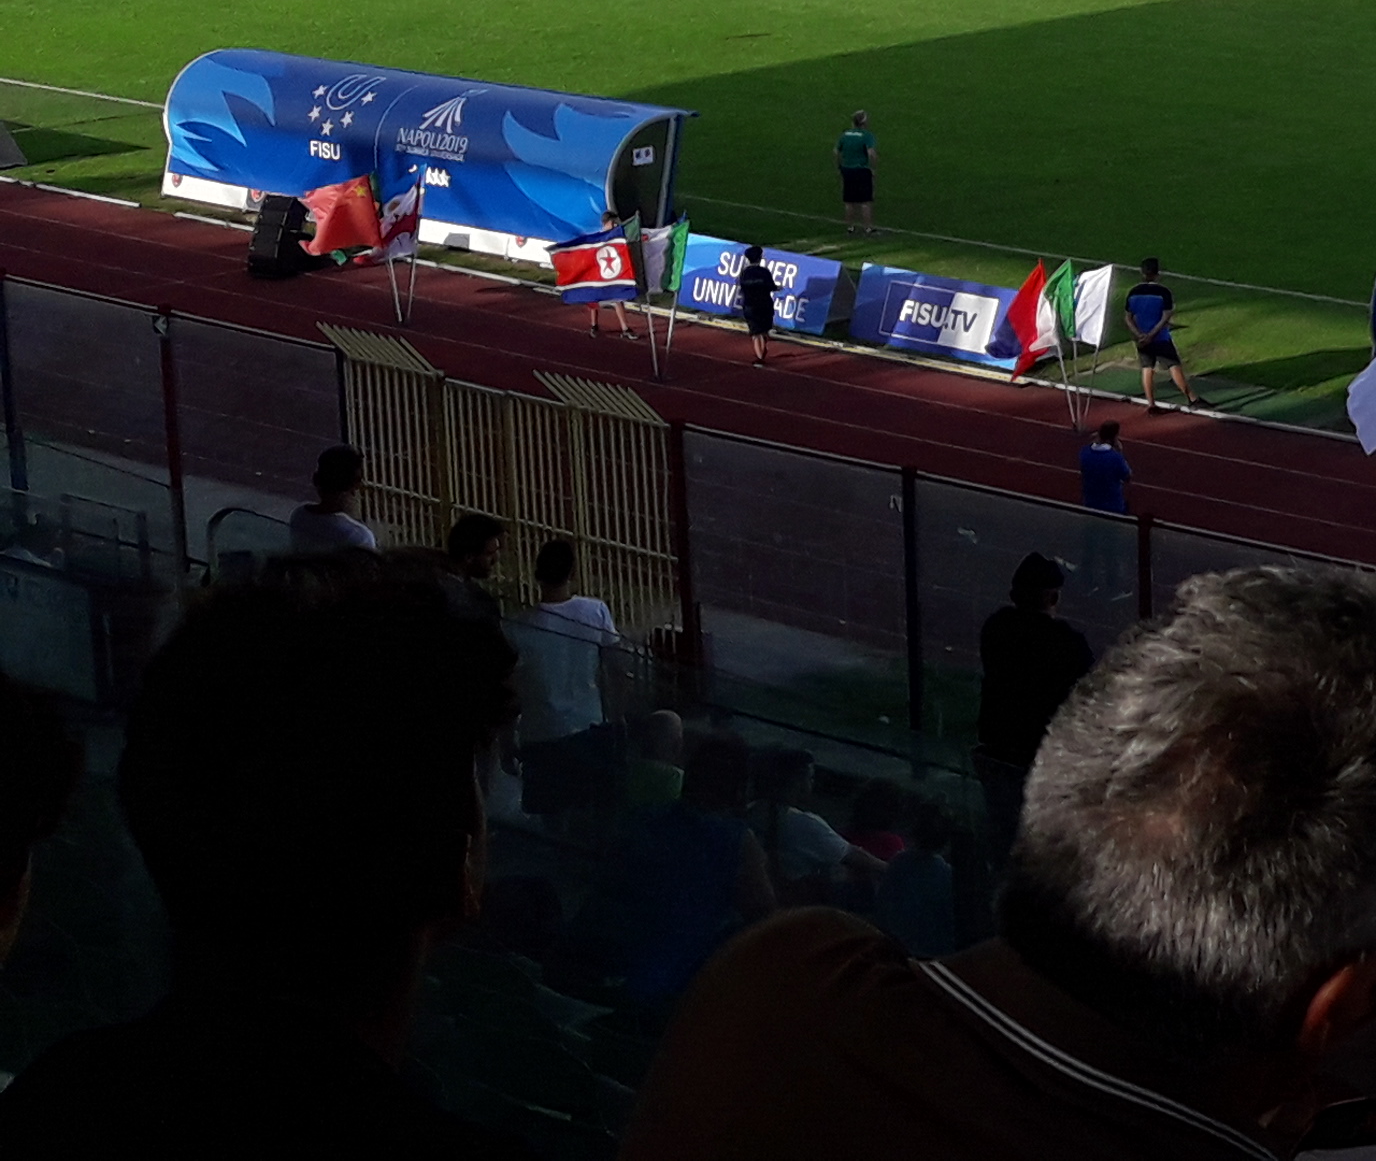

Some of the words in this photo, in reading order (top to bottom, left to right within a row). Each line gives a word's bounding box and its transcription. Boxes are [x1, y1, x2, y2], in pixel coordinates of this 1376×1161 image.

[310, 140, 341, 160] FISU
[397, 128, 468, 154] NAPOLI2019
[900, 299, 978, 333] FISU.TV
